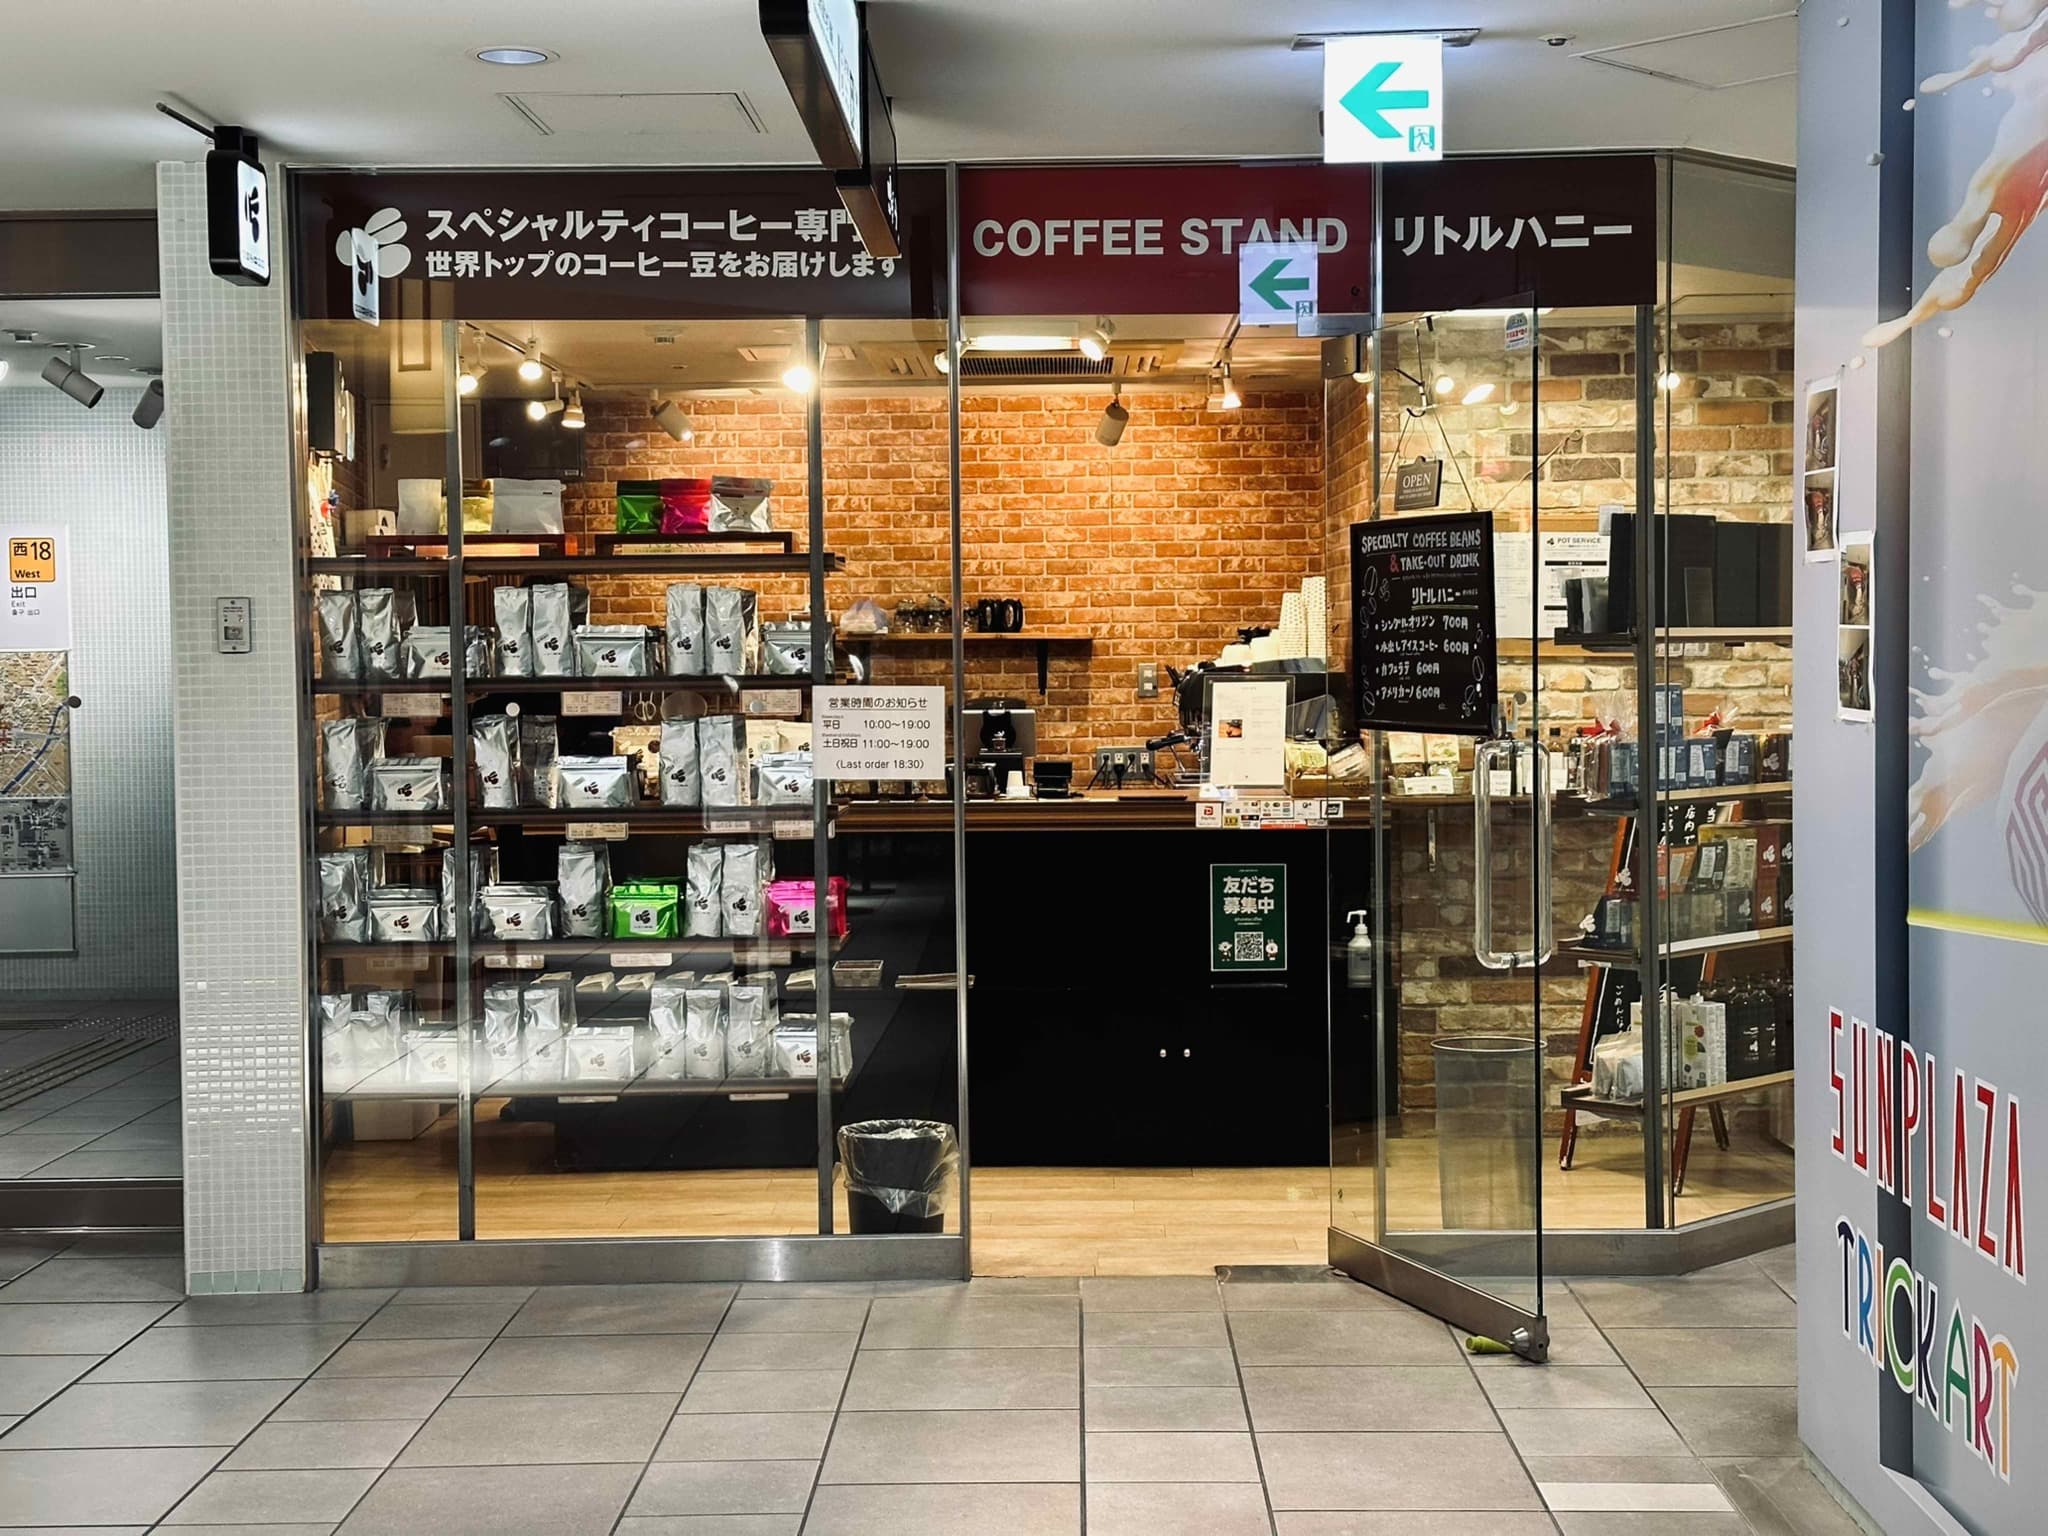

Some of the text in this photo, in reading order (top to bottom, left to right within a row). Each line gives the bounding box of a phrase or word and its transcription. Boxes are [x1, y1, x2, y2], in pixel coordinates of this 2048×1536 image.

[426, 208, 864, 243] スペシャルティコーヒー専門
[972, 216, 1348, 257] COFFEE STAND
[1394, 215, 1632, 256] リトルハニー
[425, 250, 896, 278] 世界トップのコーヒー豆をお届けします
[1402, 472, 1431, 488] OPEN
[1361, 528, 1481, 554] SPECIALTY COFFEE BEANS
[13, 541, 51, 560] 西 18
[1390, 553, 1399, 572] &
[1450, 553, 1480, 569] DRINK
[15, 569, 40, 578] West
[11, 586, 37, 598] 出口
[1412, 587, 1461, 605] リトルハニー
[1442, 615, 1468, 630] 700円
[1443, 639, 1469, 655] 600円
[1416, 662, 1440, 675] 600円
[1415, 686, 1440, 700] 600円
[829, 697, 928, 709] 営業時間のお知らせ
[823, 720, 840, 729] 平日
[823, 738, 858, 748] 土日祝日
[865, 760, 889, 769] order
[1223, 875, 1275, 894] 友だち
[1223, 896, 1275, 914] 募集中
[1828, 1005, 2027, 1285] SUNPLAZA
[1834, 1214, 2020, 1486] TRICK ART
